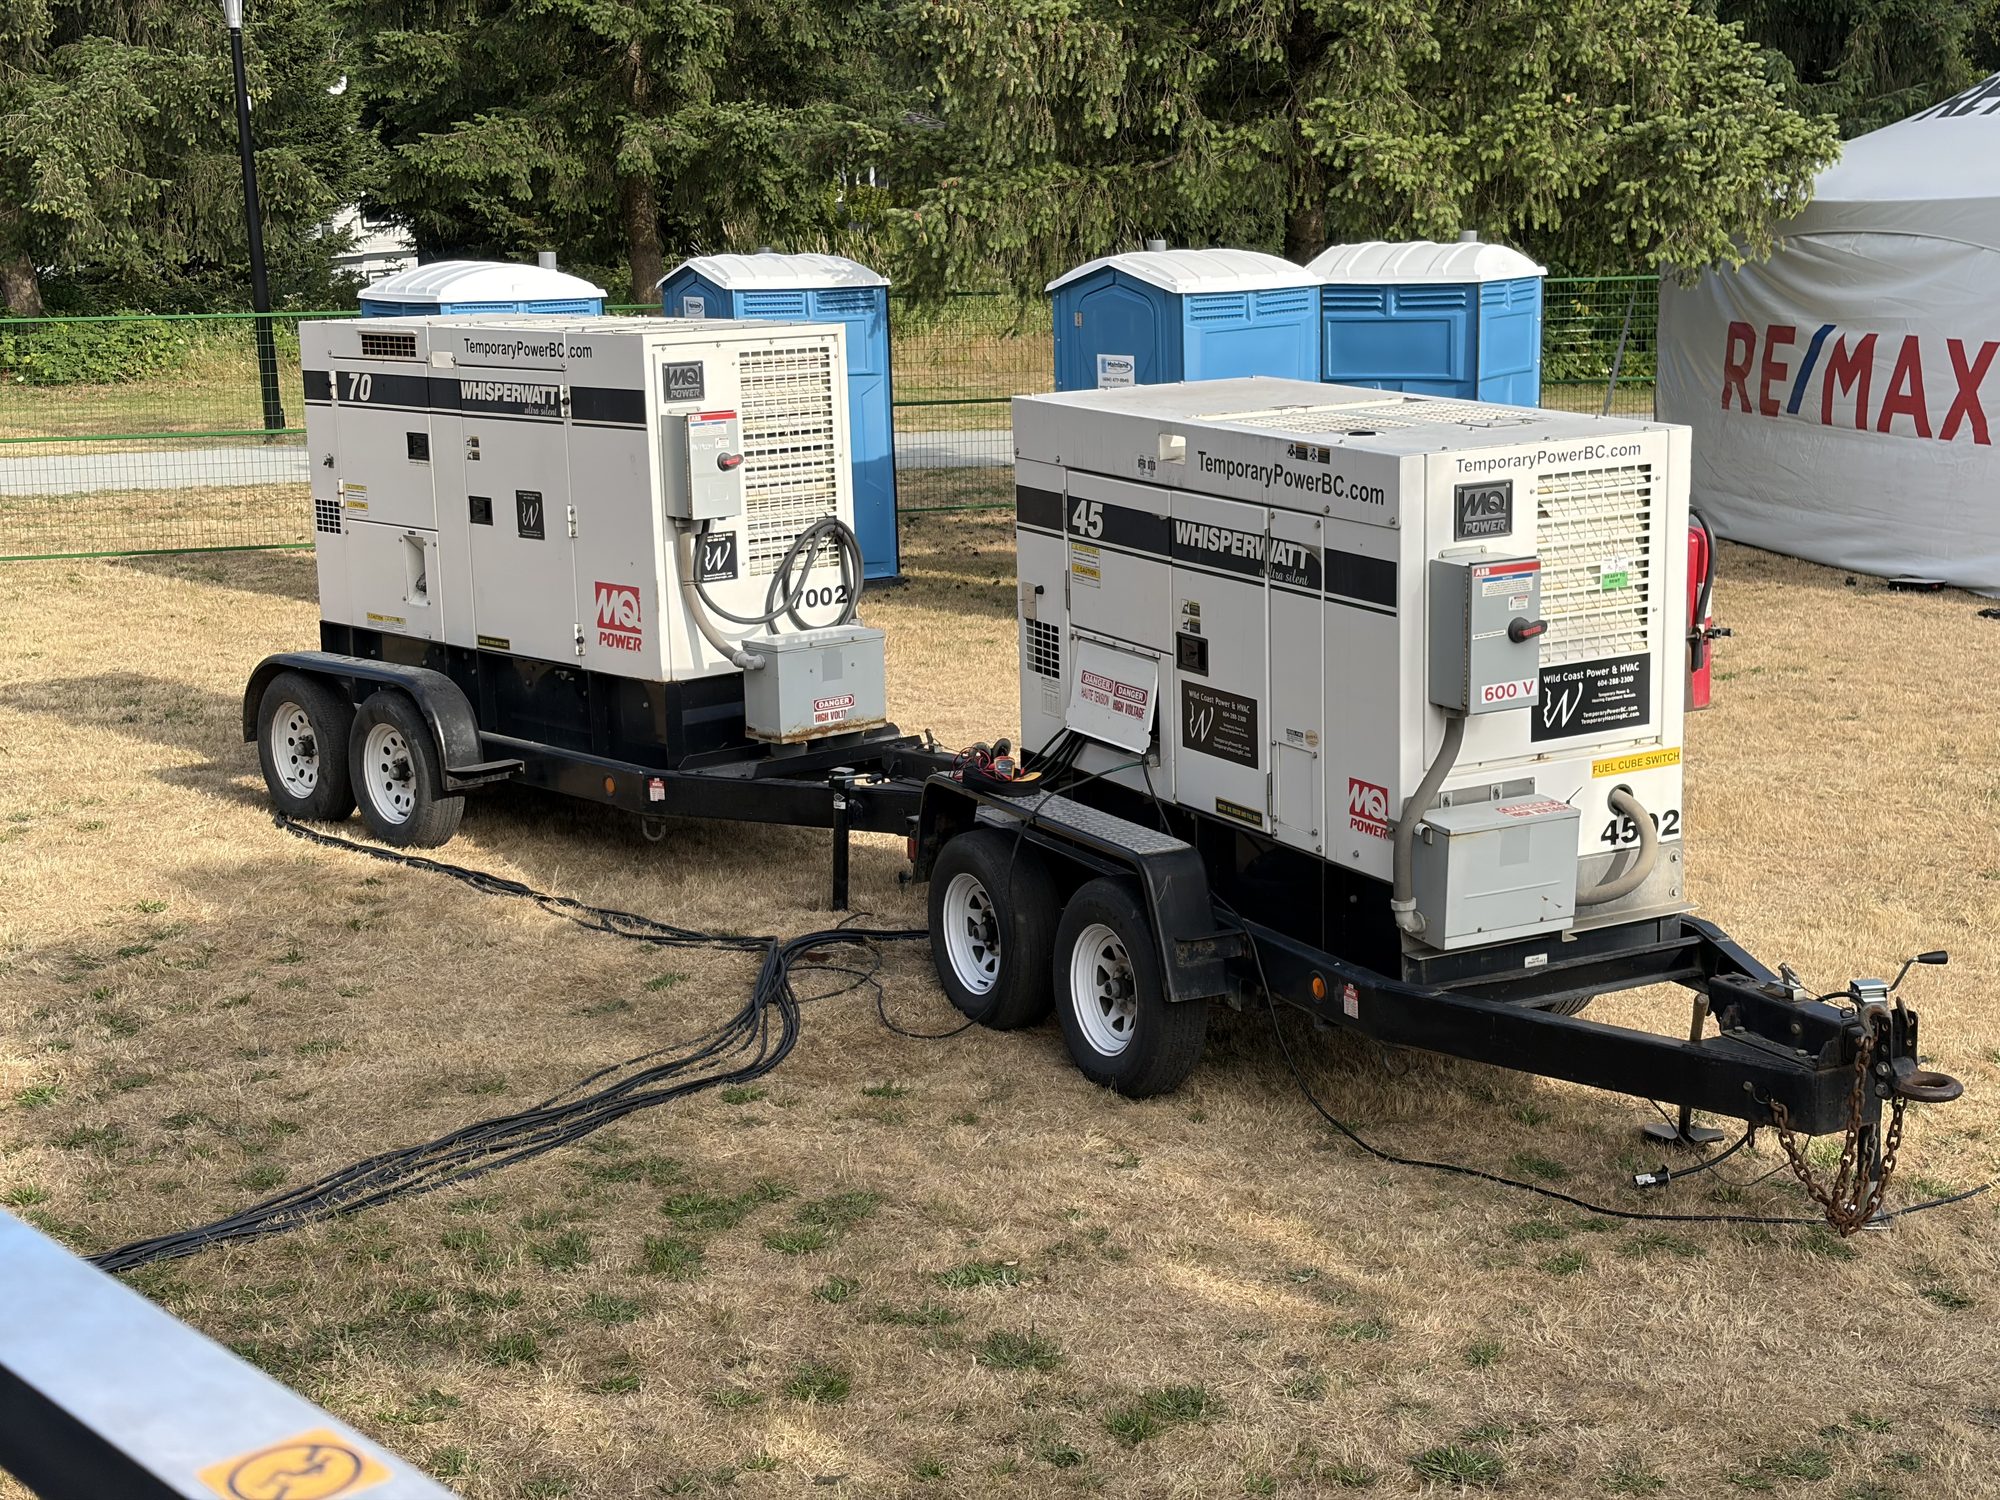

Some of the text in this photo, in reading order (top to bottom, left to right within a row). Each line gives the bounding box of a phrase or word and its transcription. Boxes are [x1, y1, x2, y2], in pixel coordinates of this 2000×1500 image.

[348, 373, 373, 401] 70
[669, 367, 700, 387] MQ
[1721, 321, 2000, 445] RE/MAX
[460, 380, 558, 406] WHISPERWATT
[671, 389, 700, 399] POWER
[540, 404, 557, 416] silent
[1456, 444, 1641, 474] TemporaryPowerBC.com
[1198, 451, 1385, 505] TemporaryPowerBC.com
[1463, 490, 1507, 518] MQ
[1072, 500, 1104, 539] 45
[1464, 520, 1506, 535] POWER
[1175, 520, 1311, 570] WHISPERWATT
[1285, 569, 1310, 586] silent
[1475, 568, 1490, 577] ABB
[596, 588, 641, 629] MQ
[599, 631, 642, 652] POWER
[1085, 674, 1111, 690] DANGER
[1543, 661, 1640, 684] Wild Coast Power & HVAC
[1597, 675, 1634, 687] 604-288-2300
[1118, 686, 1144, 701] DANGER
[1200, 693, 1214, 704] Coast
[1215, 697, 1231, 708] Power
[1484, 680, 1535, 701] 600 V
[818, 697, 850, 708] DANGER
[1112, 699, 1145, 719] HIGH VOLTAGE
[1592, 751, 1680, 775] FUEL CUBE SWITCH
[1349, 783, 1388, 821] MQ
[1350, 817, 1388, 840] POWER
